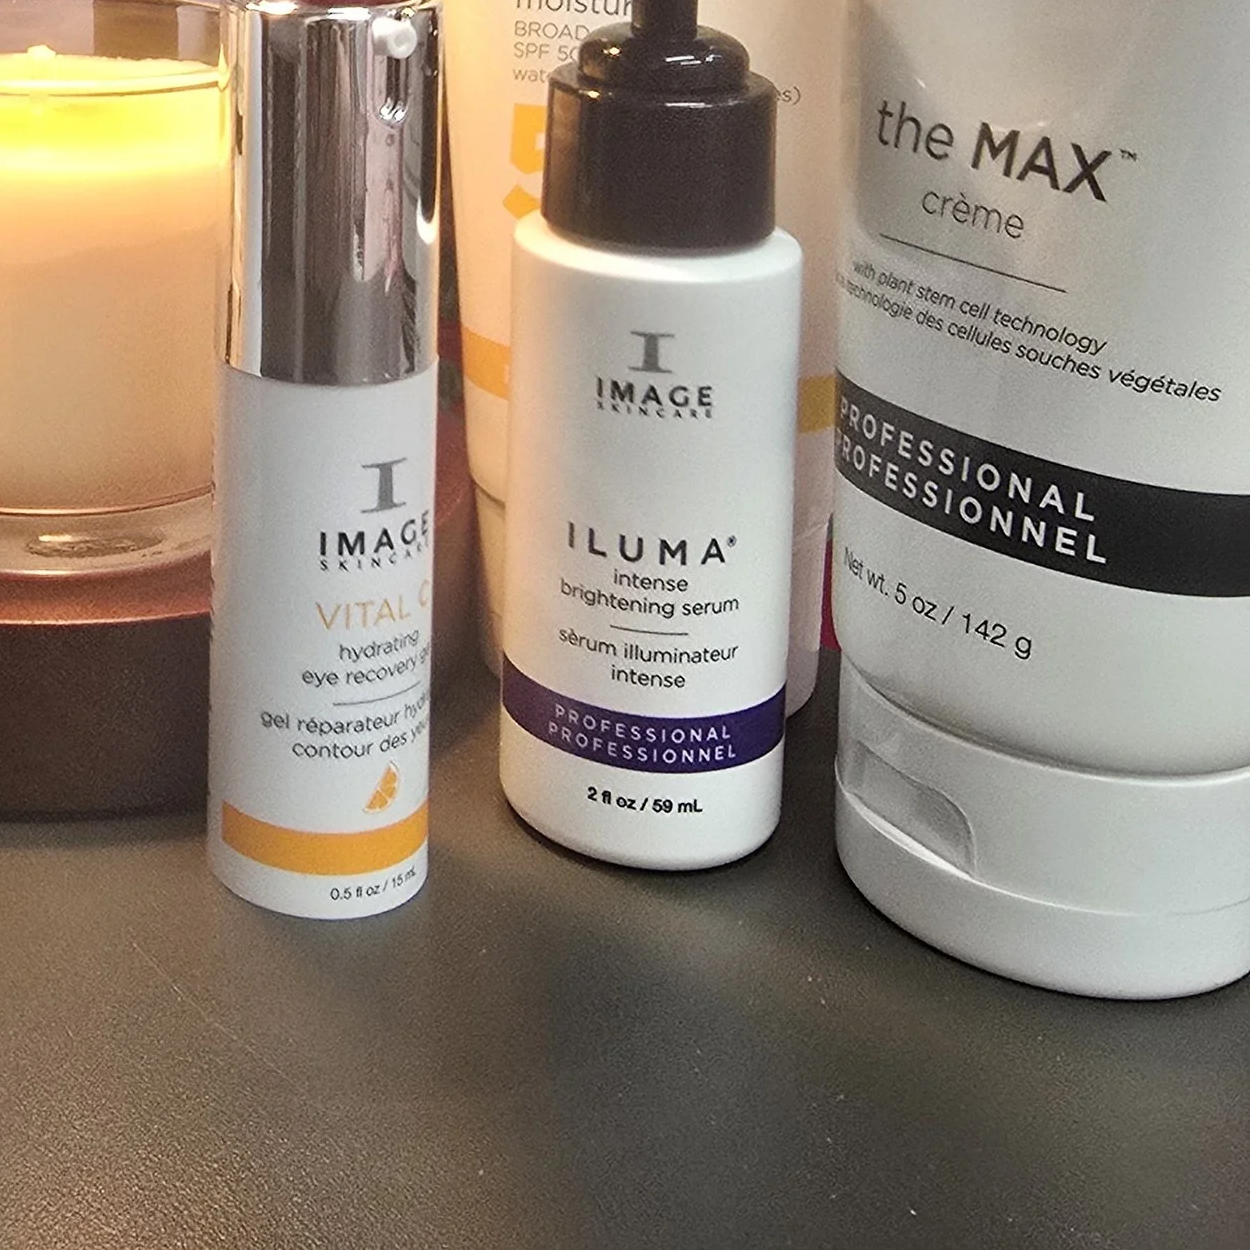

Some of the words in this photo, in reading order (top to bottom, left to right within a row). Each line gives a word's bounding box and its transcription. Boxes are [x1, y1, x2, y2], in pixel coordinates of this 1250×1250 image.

[514, 20, 590, 41] BROAD
[513, 41, 550, 59] SPF
[877, 99, 955, 161] the
[921, 188, 1025, 240] crème
[878, 271, 915, 295] plant
[916, 285, 956, 310] stem
[959, 298, 991, 322] cell
[994, 308, 1108, 355] technology
[916, 310, 945, 331] des
[947, 321, 1012, 355] cellules
[1015, 343, 1102, 380] souches
[1108, 367, 1223, 403] végétales
[597, 375, 713, 408] IMAGE
[597, 400, 713, 419] SKINCARE
[841, 396, 1095, 523] PROFESSIONAL
[320, 509, 429, 557] IMAGE
[613, 568, 689, 592] intense
[315, 594, 412, 631] VITAL
[560, 578, 675, 619] brightening
[682, 598, 739, 616] serum
[844, 546, 863, 581] Net
[866, 566, 889, 596] wt.
[894, 581, 908, 605] 5
[912, 595, 937, 622] oz
[941, 605, 955, 625] /
[962, 612, 1007, 648] 142
[1015, 636, 1033, 660] g
[339, 629, 420, 663] hydrating
[623, 643, 739, 664] illuminateur
[301, 670, 339, 687] eye
[346, 656, 416, 685] recovery
[611, 664, 686, 688] intense
[261, 711, 290, 730] gel
[297, 710, 400, 737] réparateur
[555, 703, 731, 744] PROFESSIONAL
[292, 740, 374, 760] contour
[379, 731, 407, 753] des
[549, 721, 737, 765] PROFESSIONNEL
[587, 786, 598, 802] 2
[601, 789, 612, 803] fl
[616, 795, 637, 811] oz
[640, 797, 649, 812] /
[652, 798, 673, 813] 59
[677, 799, 703, 813] mL
[330, 887, 352, 901] 0.5
[355, 886, 363, 898] fl
[366, 885, 381, 897] oz
[382, 878, 389, 892] /
[392, 873, 404, 888] 15
